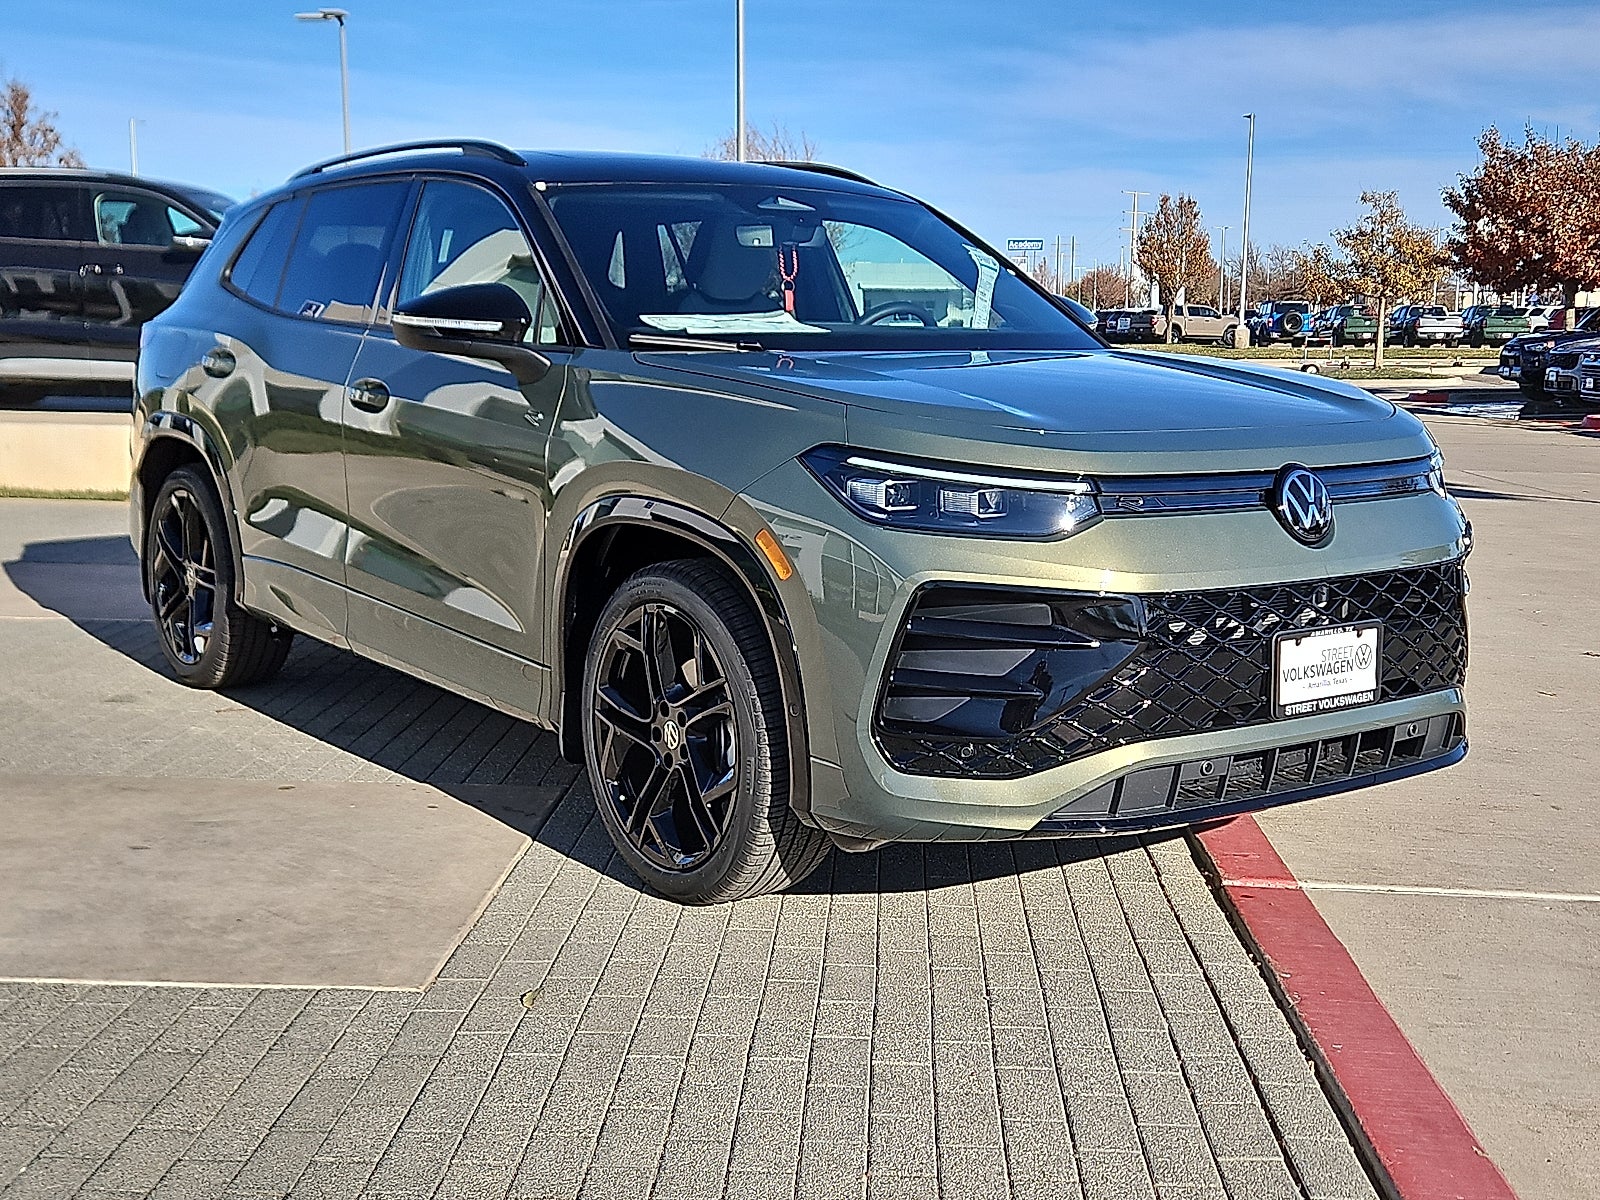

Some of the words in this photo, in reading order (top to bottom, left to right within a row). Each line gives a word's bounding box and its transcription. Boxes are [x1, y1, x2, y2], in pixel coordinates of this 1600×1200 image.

[1008, 240, 1043, 250] Academy
[1321, 645, 1354, 662] STREET
[1282, 659, 1354, 682] VOLKSWAGEN
[1284, 701, 1318, 716] STREET
[1318, 691, 1374, 710] VOLKSWAGEN
